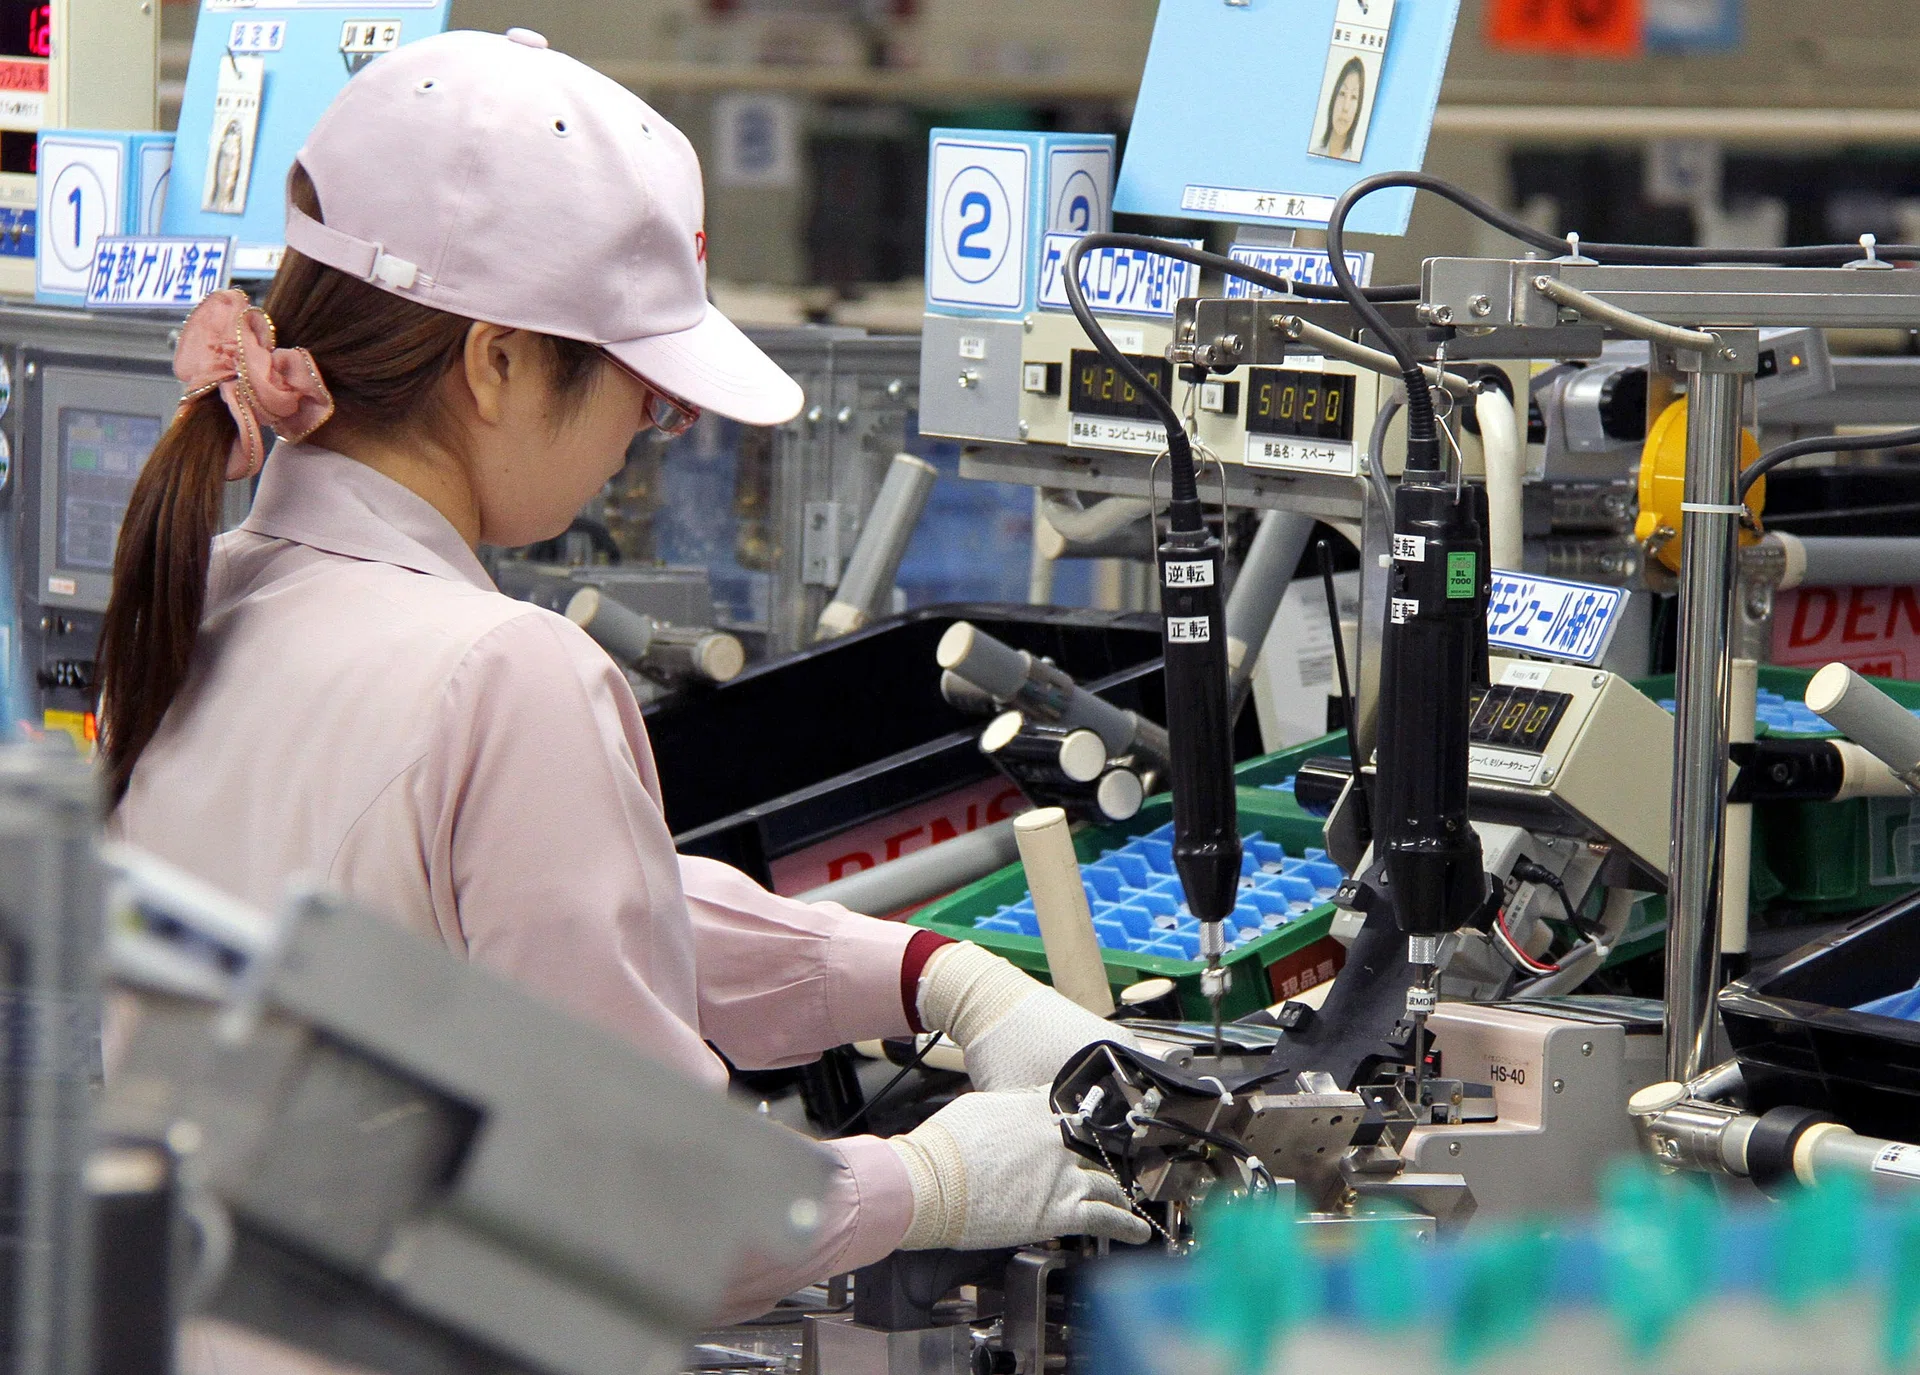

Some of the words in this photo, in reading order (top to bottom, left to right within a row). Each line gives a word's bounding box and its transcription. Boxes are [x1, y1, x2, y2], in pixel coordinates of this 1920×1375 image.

[68, 187, 82, 248] 1
[957, 191, 991, 260] 2
[1258, 384, 1340, 422] 5020
[1301, 448, 1336, 463] スペーサ
[1168, 564, 1205, 583] 逆転
[1450, 577, 1472, 585] 7000
[1171, 620, 1208, 639] 正転
[1490, 1064, 1526, 1085] HS-40
